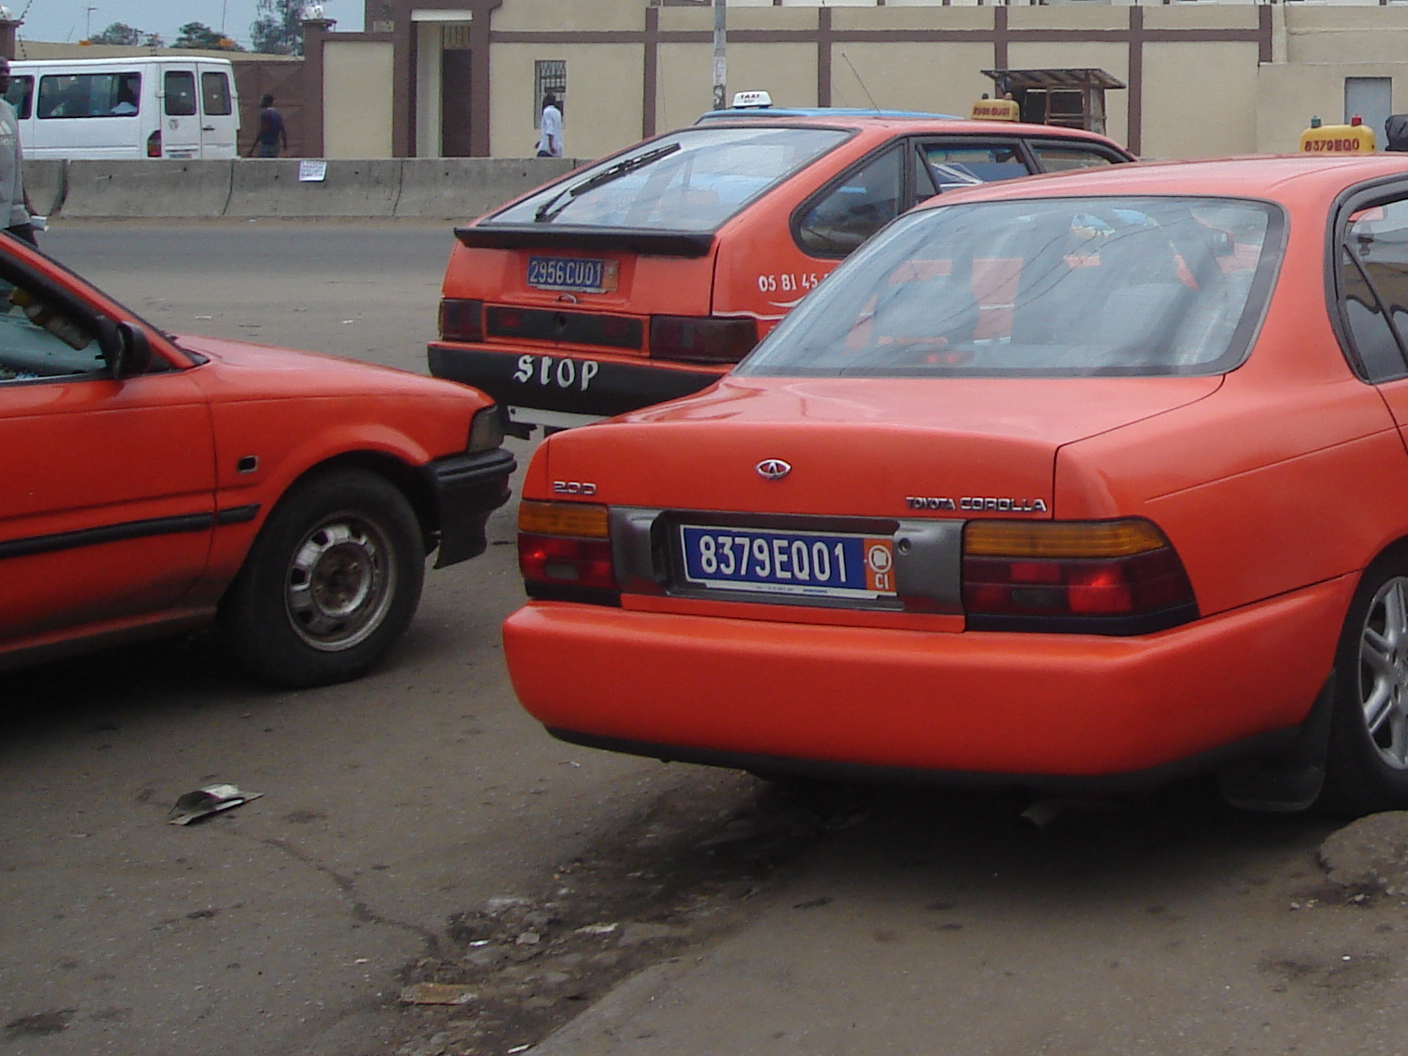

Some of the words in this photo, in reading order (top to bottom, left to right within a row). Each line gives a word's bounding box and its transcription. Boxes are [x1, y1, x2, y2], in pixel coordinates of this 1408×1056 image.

[529, 260, 601, 286] 2956CU01
[758, 274, 777, 292] 05
[781, 273, 798, 291] 81
[801, 272, 818, 290] 45
[905, 496, 956, 511] TOYOTA
[959, 497, 1047, 512] COROLLA
[699, 534, 847, 583] 8379EQ01
[874, 573, 889, 590] CI
